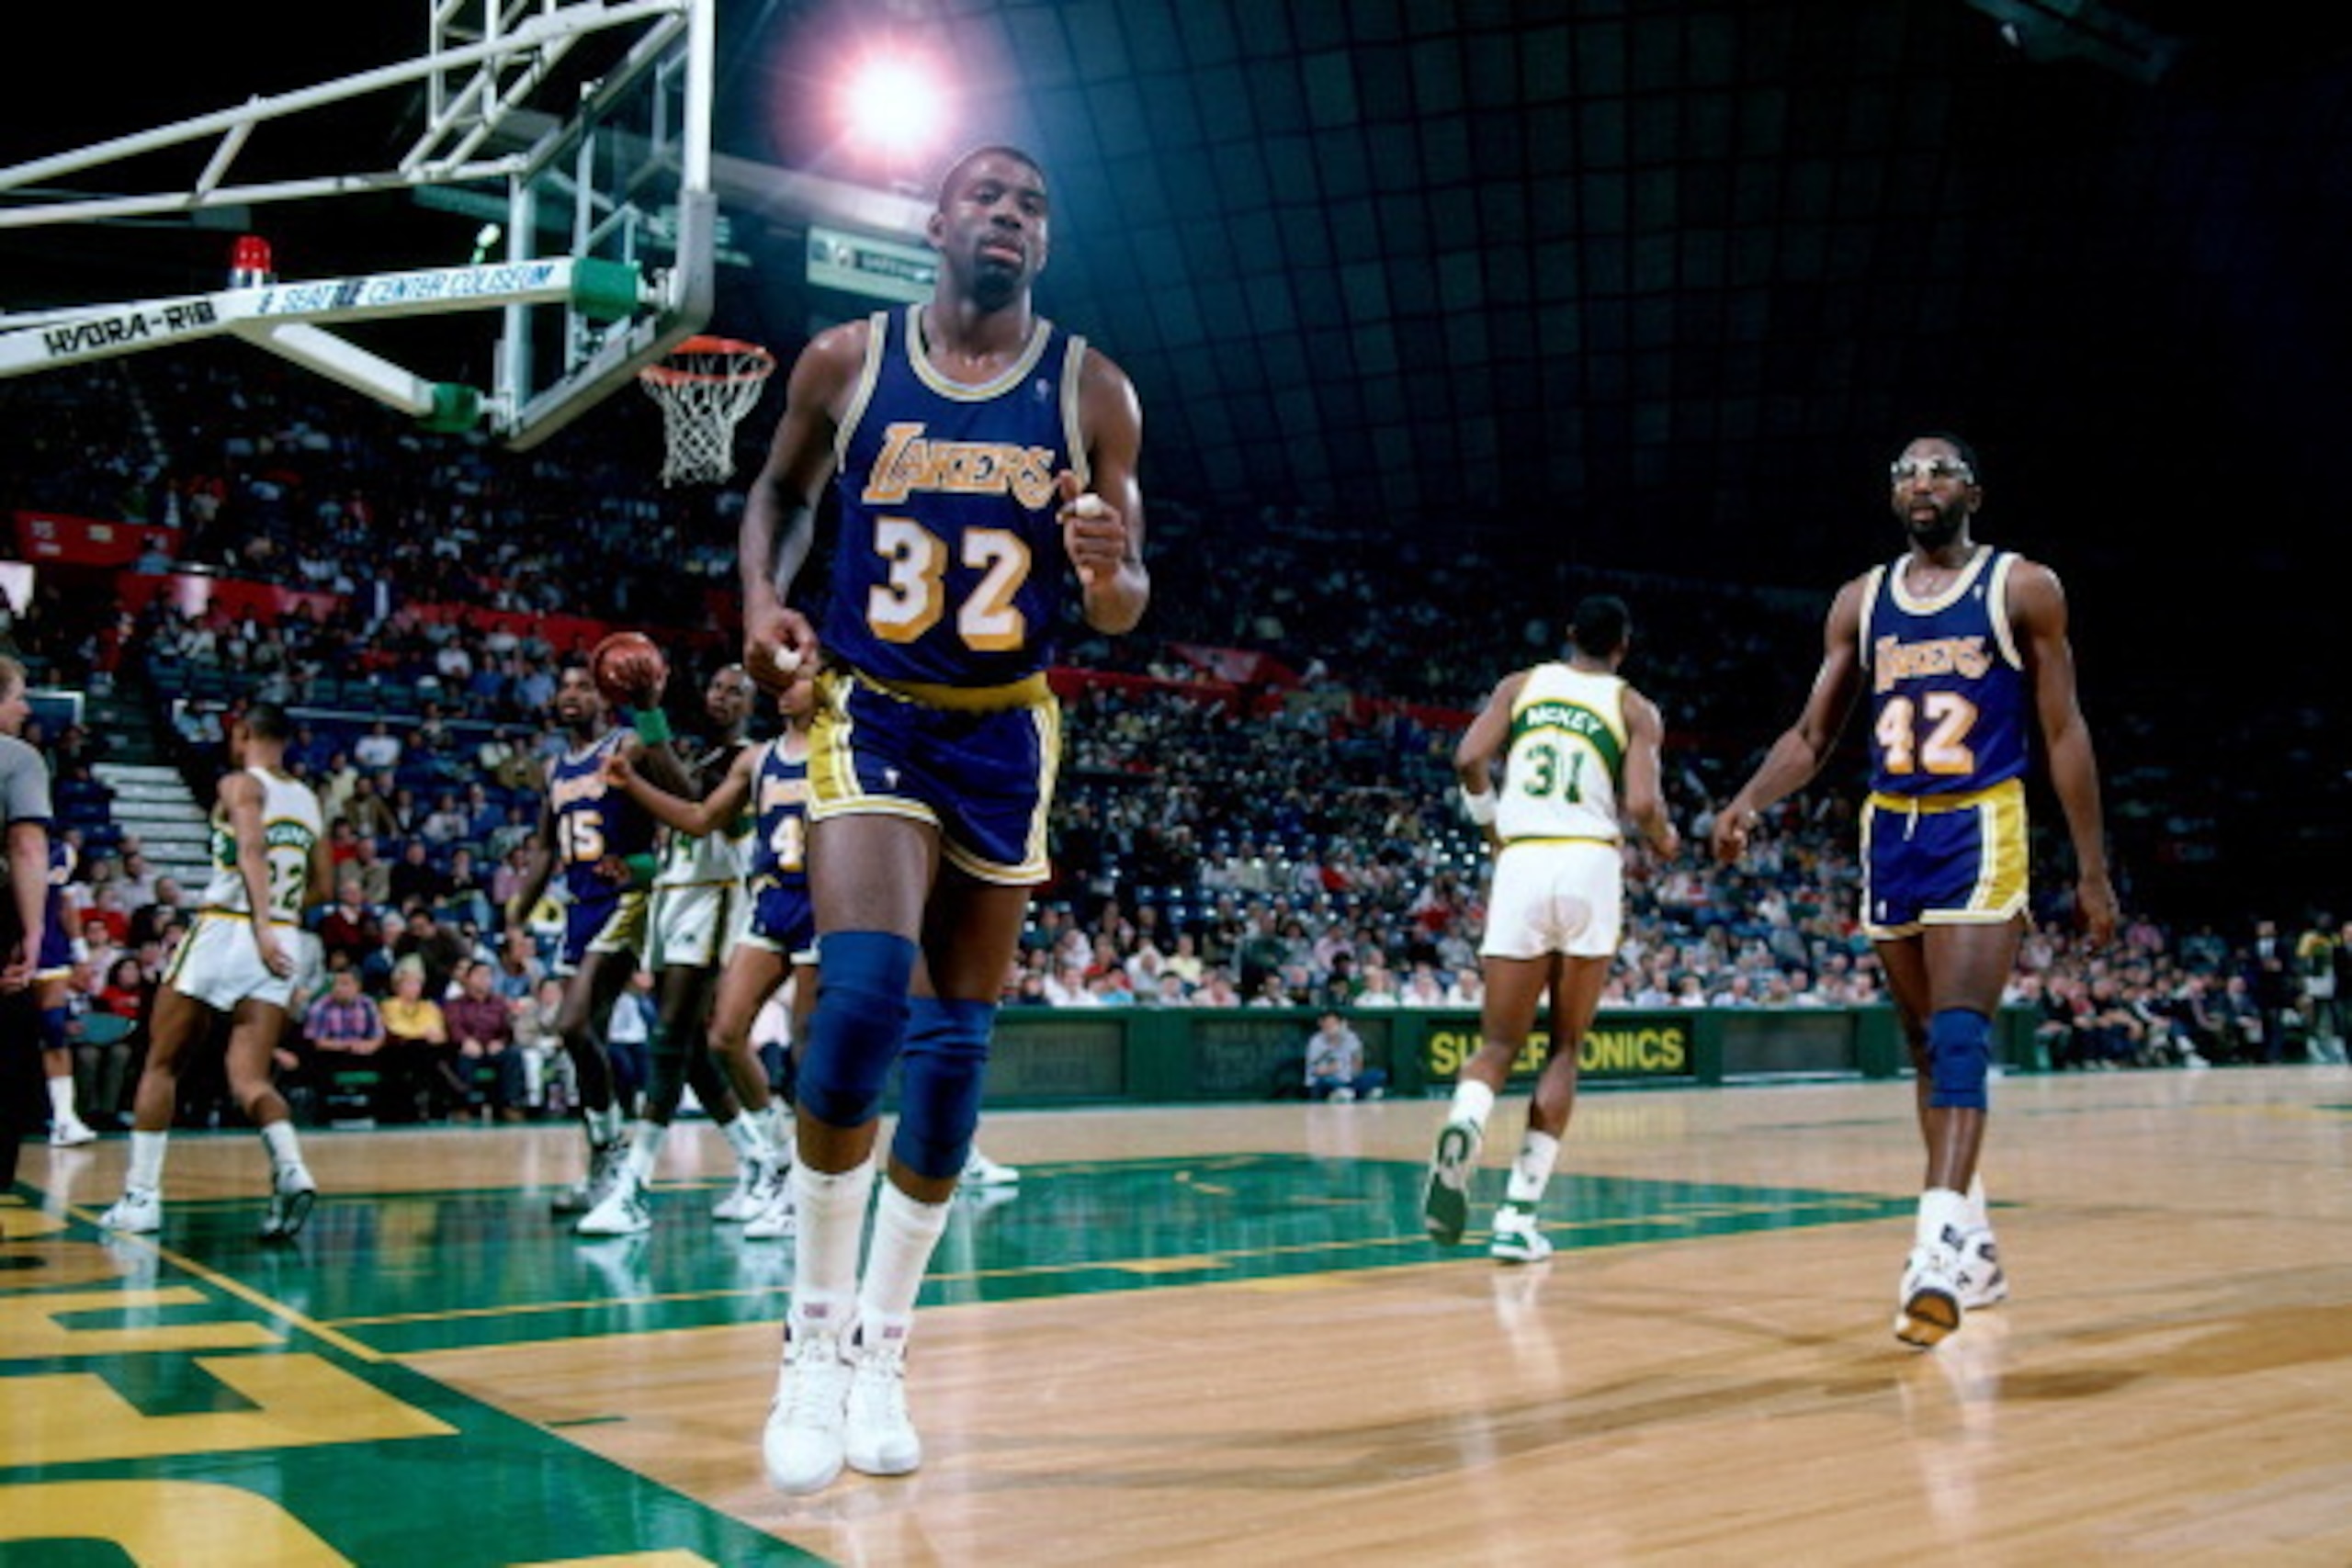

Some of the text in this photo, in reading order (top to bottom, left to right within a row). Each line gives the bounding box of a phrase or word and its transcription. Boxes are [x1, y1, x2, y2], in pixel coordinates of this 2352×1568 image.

[867, 517, 1031, 650] 32
[1875, 692, 1979, 774] 42
[1523, 743, 1585, 805] 31
[557, 810, 605, 863] 15
